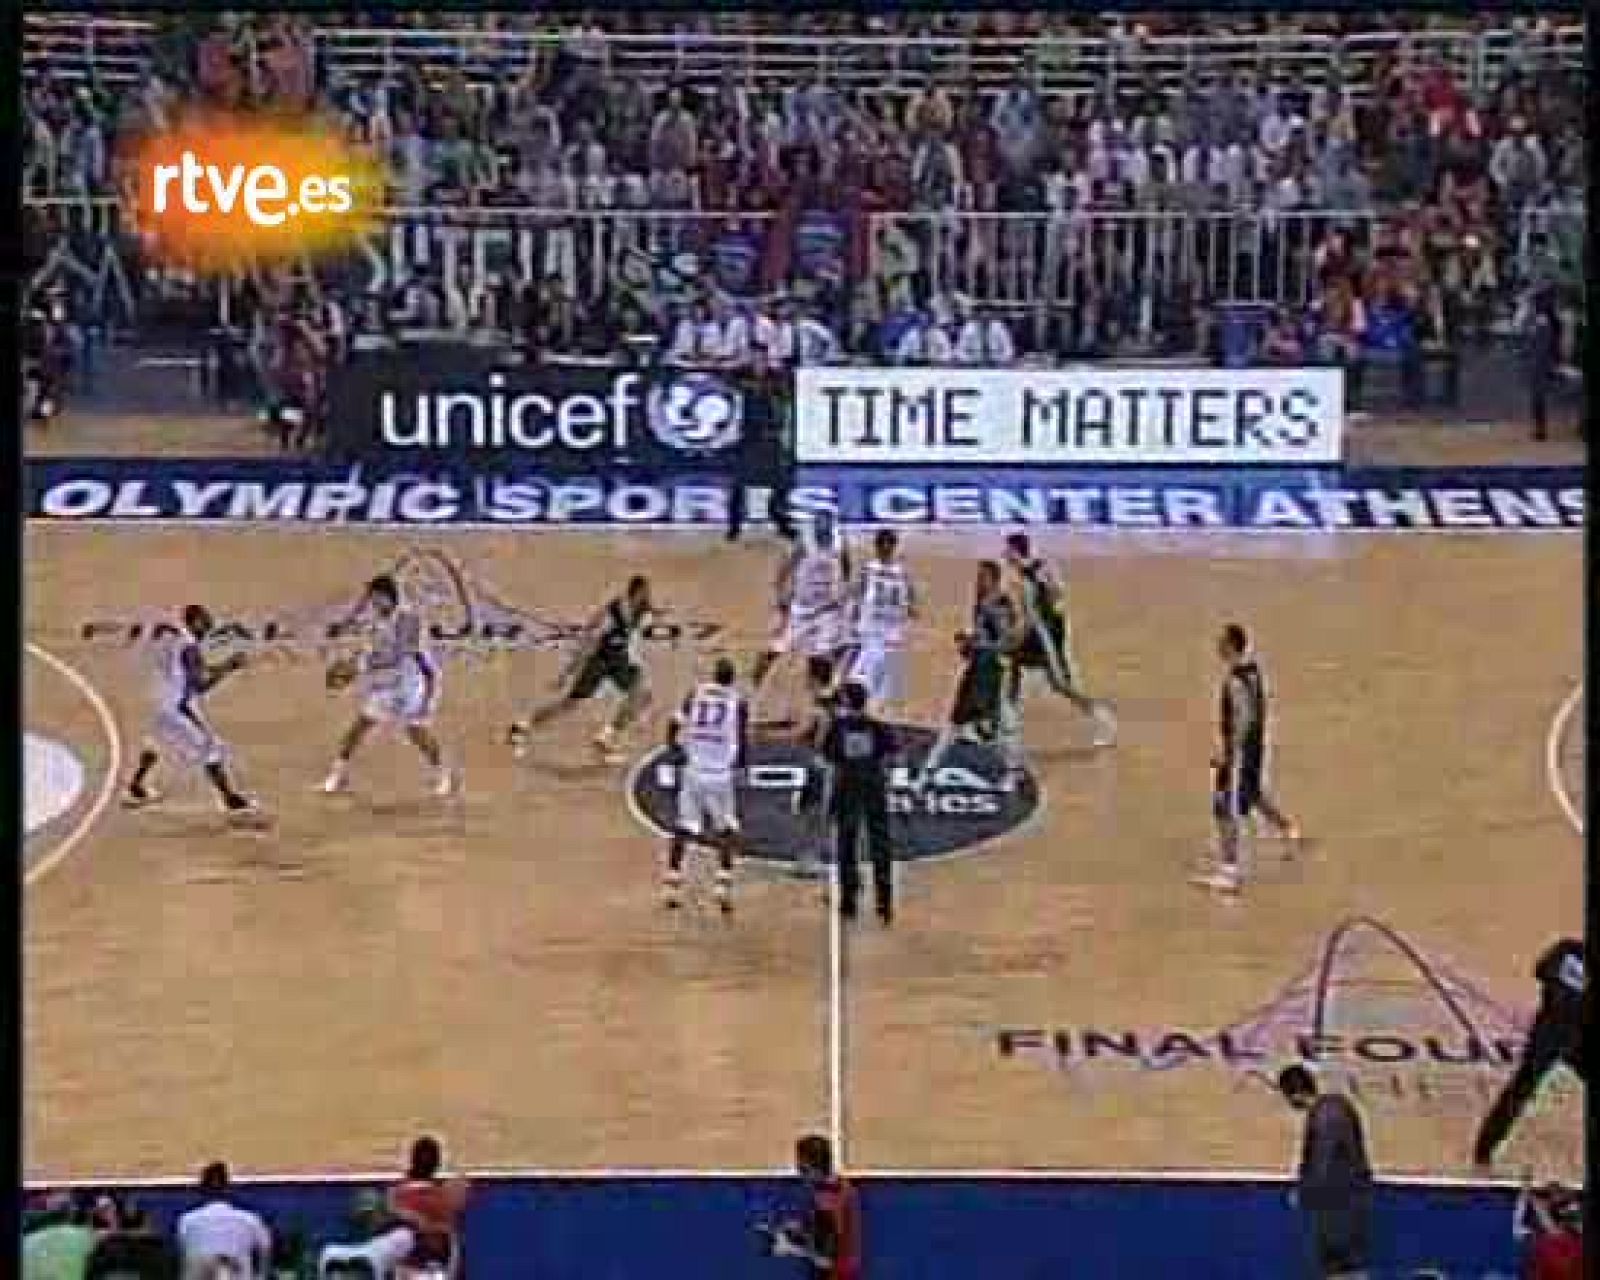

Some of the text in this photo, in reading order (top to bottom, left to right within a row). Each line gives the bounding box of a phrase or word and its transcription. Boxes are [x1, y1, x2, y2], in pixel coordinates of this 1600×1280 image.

[381, 372, 641, 449] unicef
[818, 387, 1320, 447] TIME MATTERS
[42, 480, 461, 519] OLYMPIC
[870, 487, 1222, 524] CENTER
[997, 1029, 1266, 1061] FINAL
